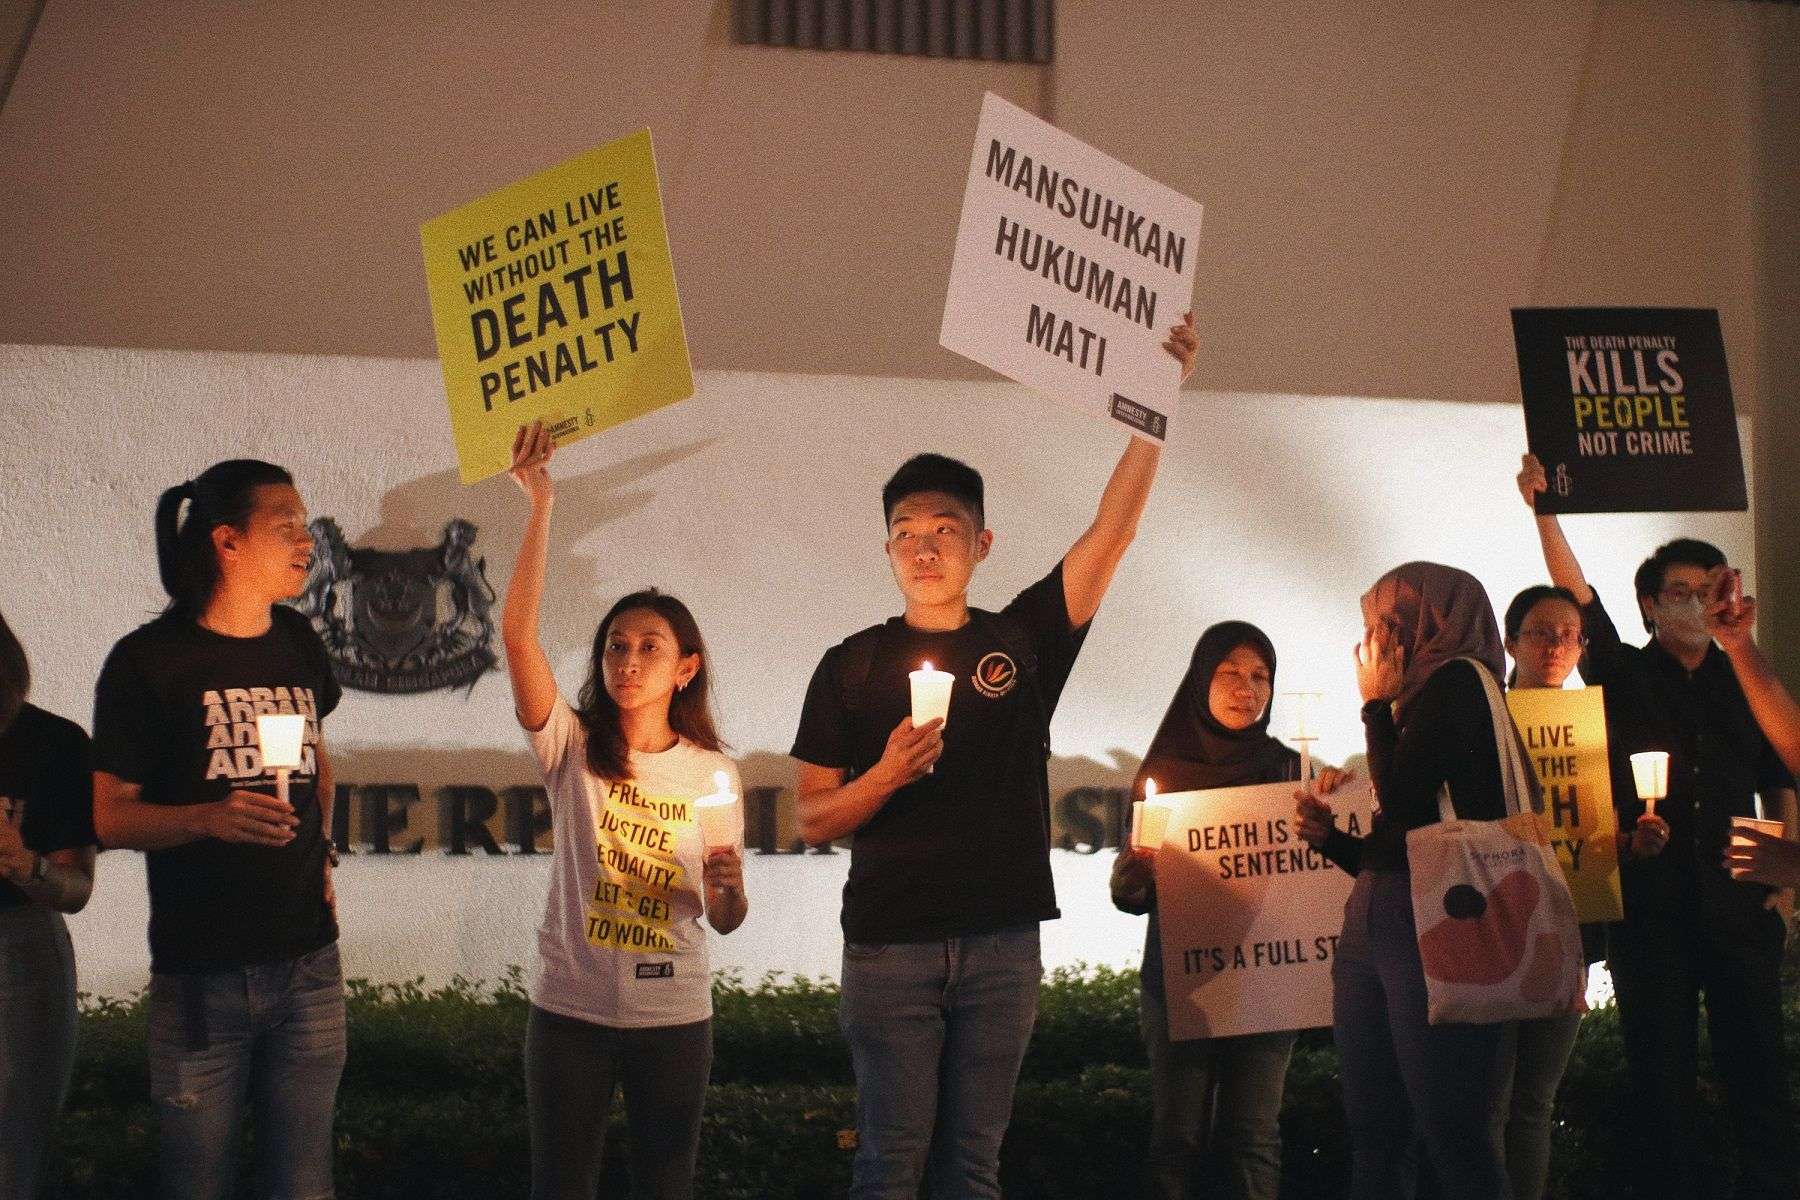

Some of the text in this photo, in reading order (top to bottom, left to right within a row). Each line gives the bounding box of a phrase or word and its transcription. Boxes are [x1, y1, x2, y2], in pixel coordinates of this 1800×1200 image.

[458, 182, 623, 272] WE CAN LIVE
[985, 138, 1187, 275] MANSUHKAN
[463, 216, 629, 305] WITHOUT THE
[995, 215, 1157, 331] HUKUMAN
[470, 252, 634, 363] DEATH
[1026, 304, 1106, 377] MATI
[1565, 335, 1677, 349] THE DEATH PENALTY
[480, 312, 641, 412] PENALTY
[1566, 350, 1684, 395] KILLS
[1573, 395, 1690, 429] PEOPLE
[1577, 431, 1694, 456] NOT CRIME
[1527, 725, 1576, 749] LIVE
[1537, 756, 1578, 777] THE
[599, 810, 673, 854] JUSTICE.
[1188, 821, 1258, 852] DEATH
[1267, 819, 1288, 845] IS
[1348, 813, 1361, 836] A
[589, 917, 611, 940] TO
[638, 896, 670, 922] GET
[1184, 946, 1225, 975] IT'S
[1232, 946, 1246, 970] A
[1252, 939, 1309, 968] FULL
